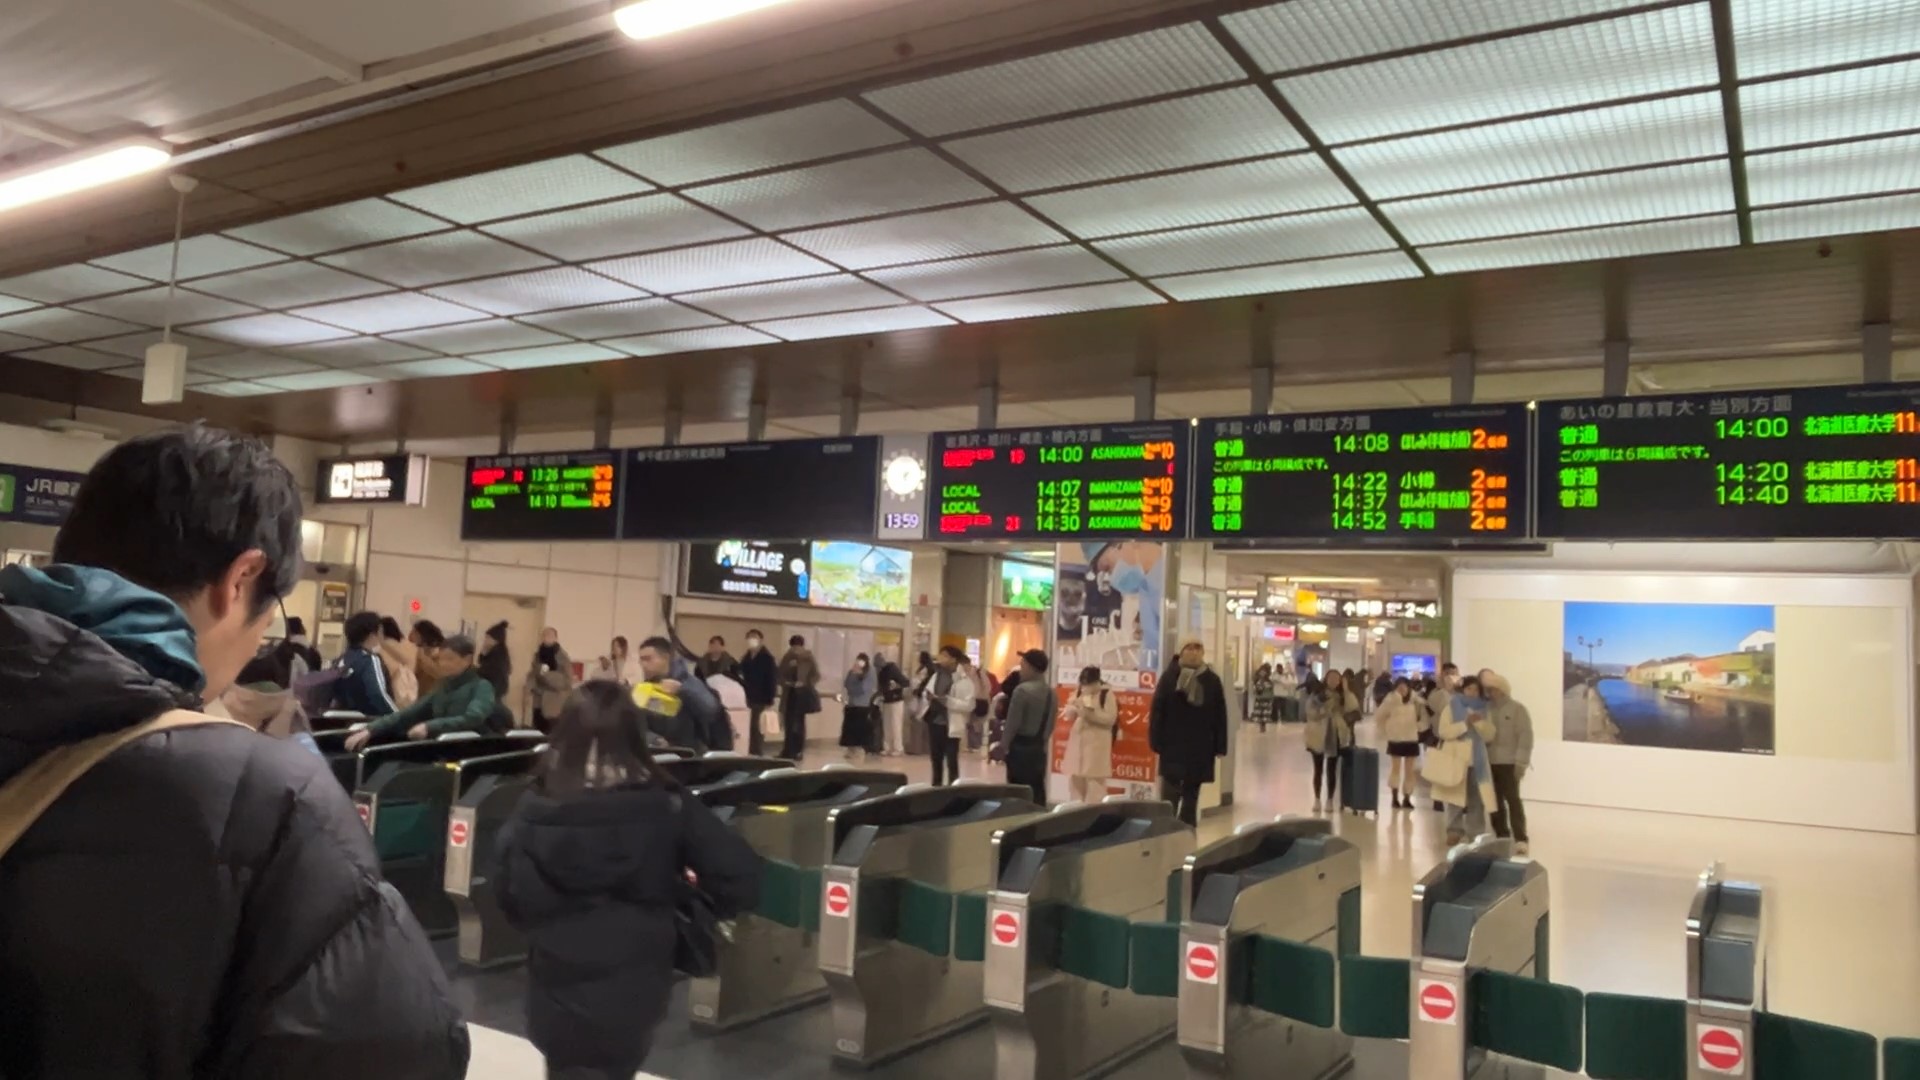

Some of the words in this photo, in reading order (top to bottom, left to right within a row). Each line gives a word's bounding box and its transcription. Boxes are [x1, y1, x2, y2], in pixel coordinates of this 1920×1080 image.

[1559, 425, 1598, 445] 普通
[1716, 417, 1789, 439] 14:00
[1333, 433, 1390, 453] 14:08
[1039, 445, 1083, 464] 14:00
[1332, 471, 1388, 491] 14:22
[1559, 466, 1598, 487] 普通
[1716, 461, 1789, 483] 14:20
[942, 485, 981, 498] LOCAL
[1037, 480, 1081, 498] 14:07
[1559, 488, 1598, 508] 普通
[1716, 484, 1789, 505] 14:40
[941, 501, 980, 514] LOCAL
[1036, 498, 1080, 514] 14:23
[1332, 491, 1388, 511] 14:37
[1036, 514, 1080, 532] 14:30
[1331, 510, 1387, 530] 14:52
